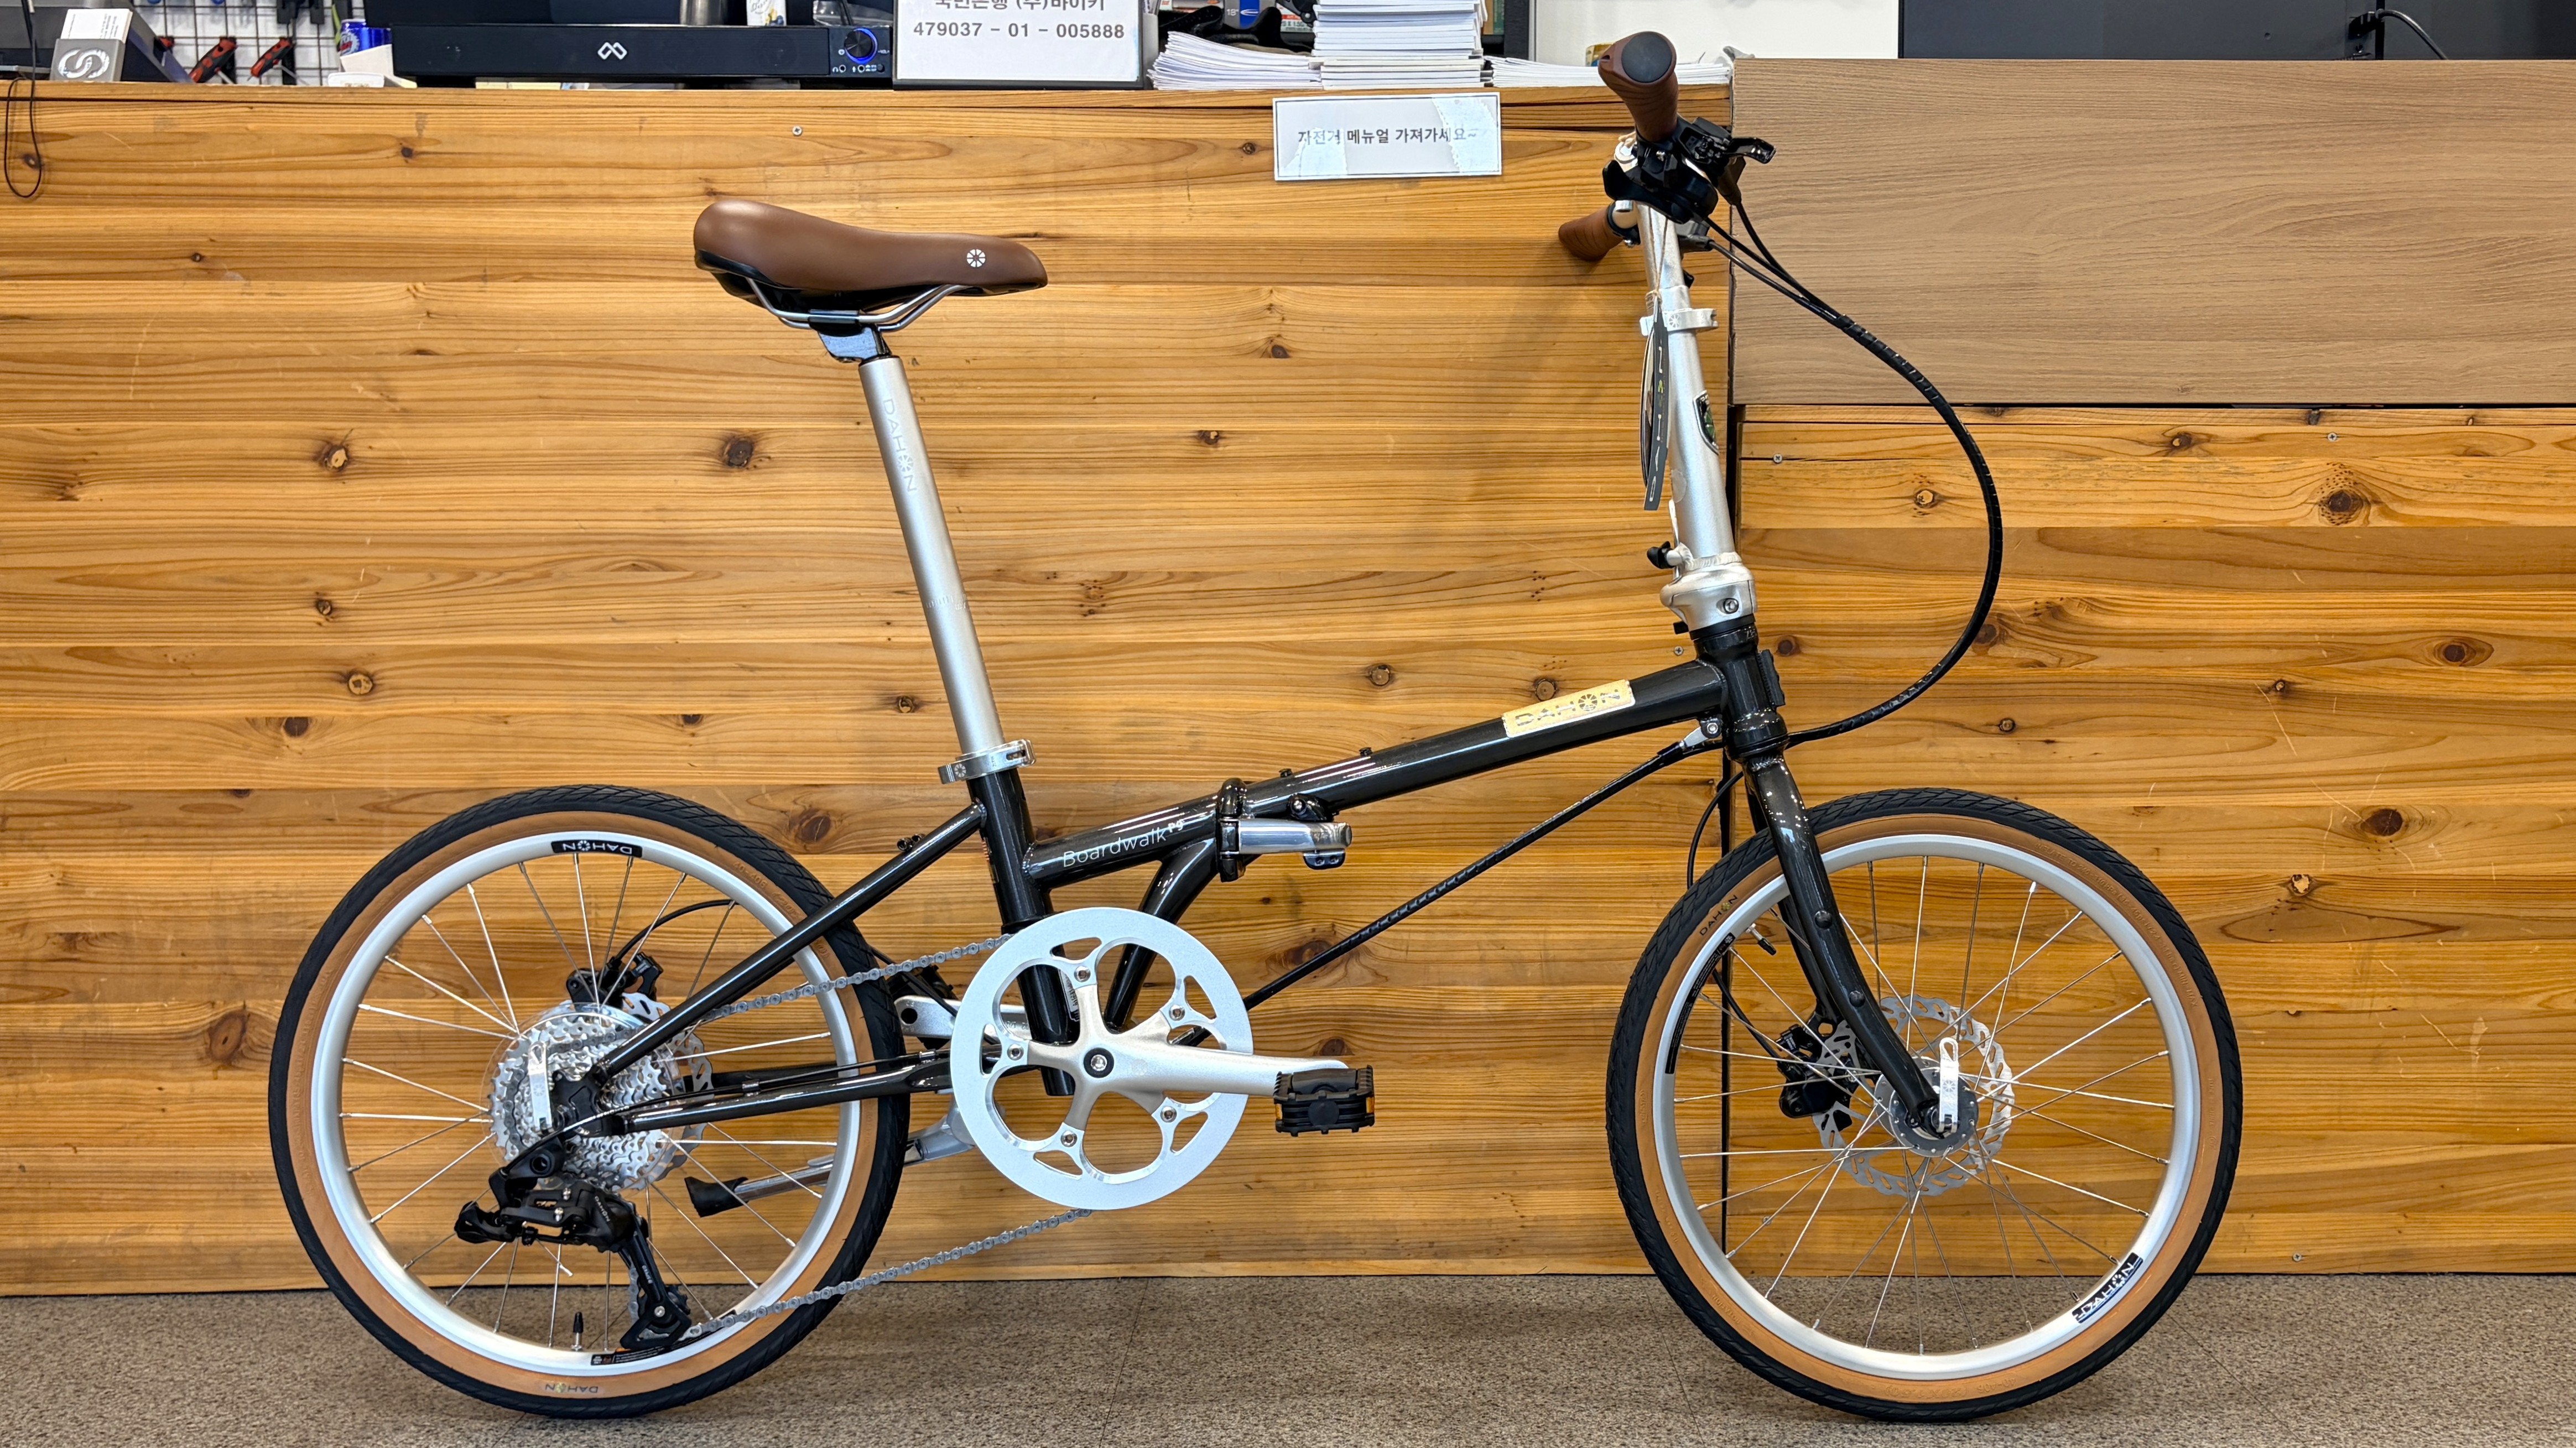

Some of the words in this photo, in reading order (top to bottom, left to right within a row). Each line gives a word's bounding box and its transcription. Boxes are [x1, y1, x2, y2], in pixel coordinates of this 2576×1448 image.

[913, 22, 982, 36] 479037
[1008, 23, 1029, 37] 01
[1056, 24, 1125, 38] 005888
[1298, 129, 1340, 145] 자전거
[1347, 128, 1389, 144] 메뉴얼
[883, 399, 917, 492] DAHON
[1515, 689, 1620, 726] DAHON
[562, 840, 632, 855] DAHON
[1063, 826, 1167, 867] Boardwalk
[1699, 894, 1738, 935] DAHON
[545, 1382, 599, 1394] DAHON
